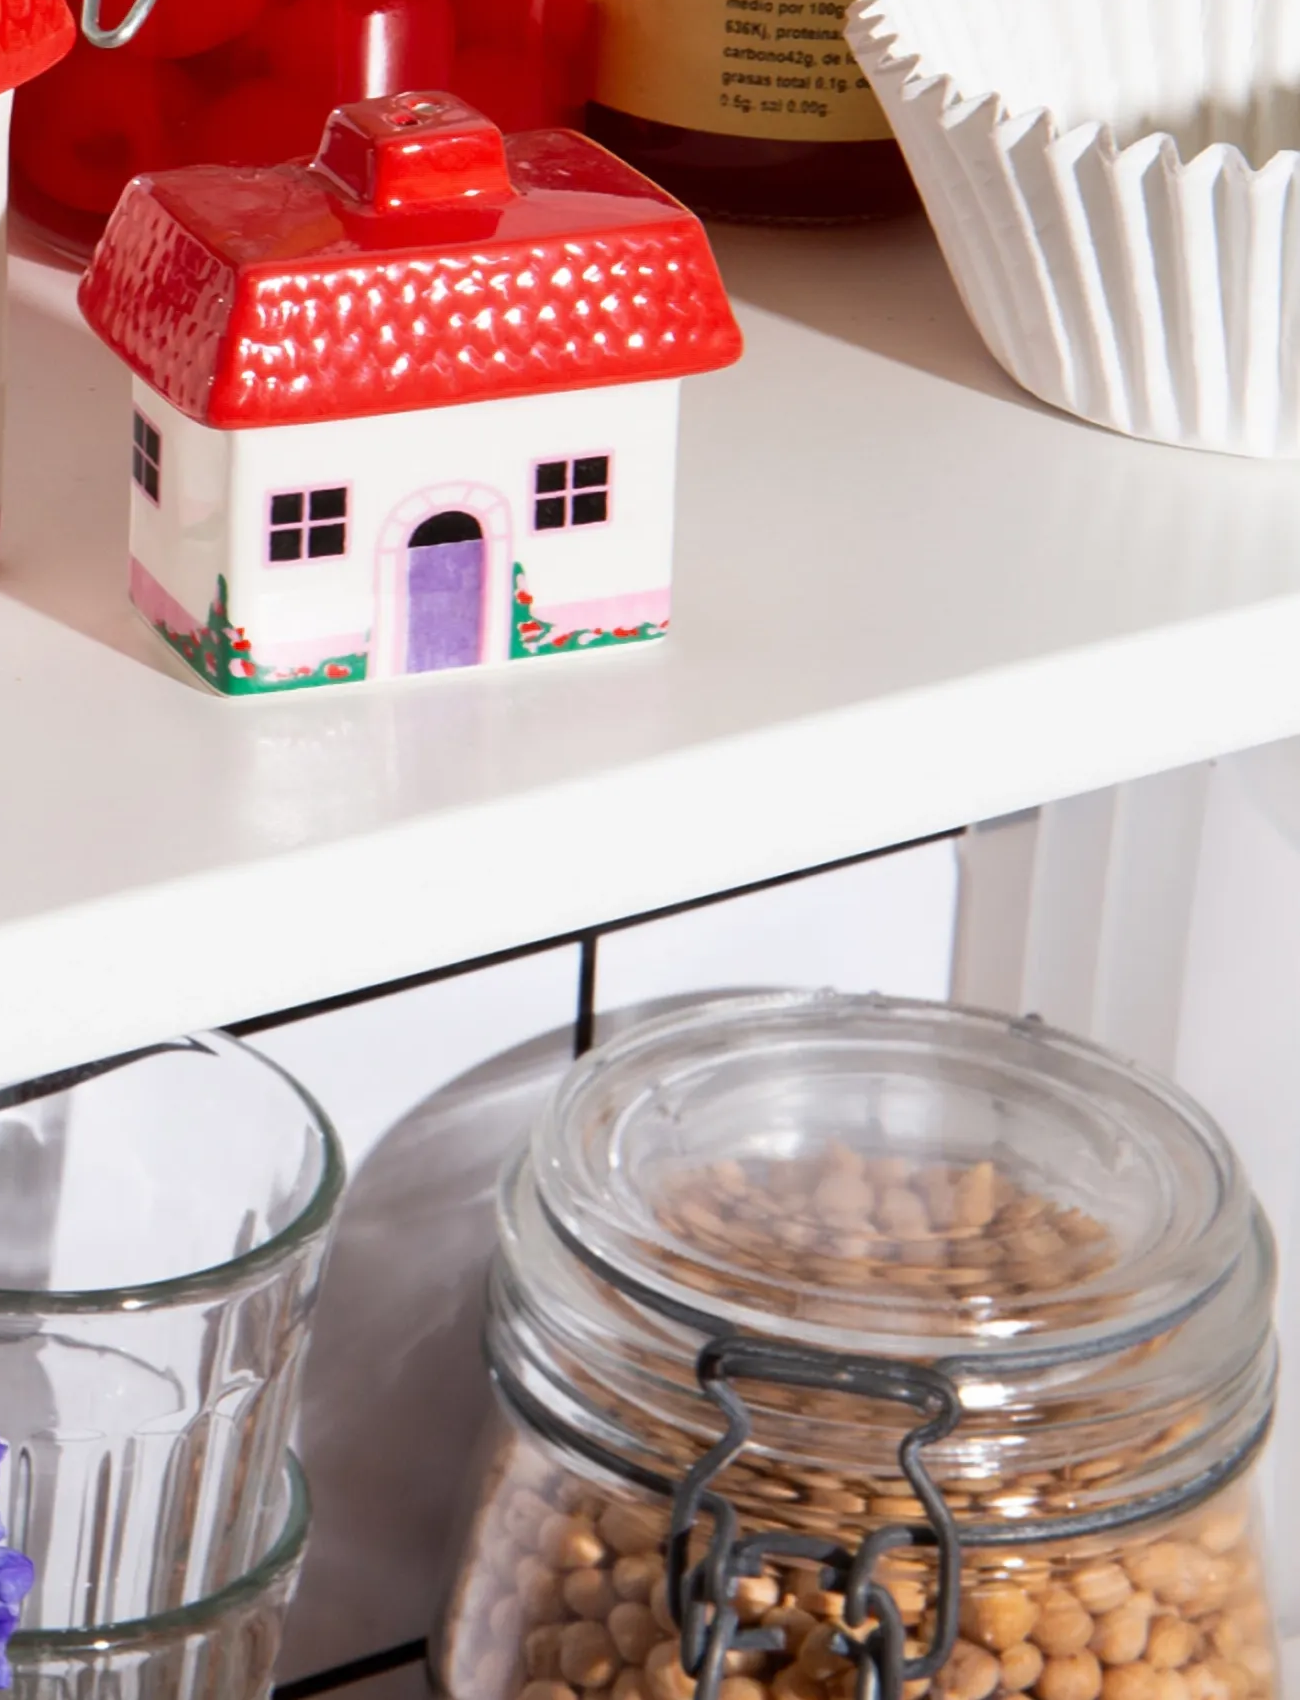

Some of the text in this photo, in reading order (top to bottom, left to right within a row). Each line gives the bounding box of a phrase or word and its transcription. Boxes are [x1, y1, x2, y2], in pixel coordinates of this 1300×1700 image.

[778, 2, 804, 17] por
[821, 52, 841, 66] de
[722, 71, 771, 87] grasas
[776, 76, 810, 89] total
